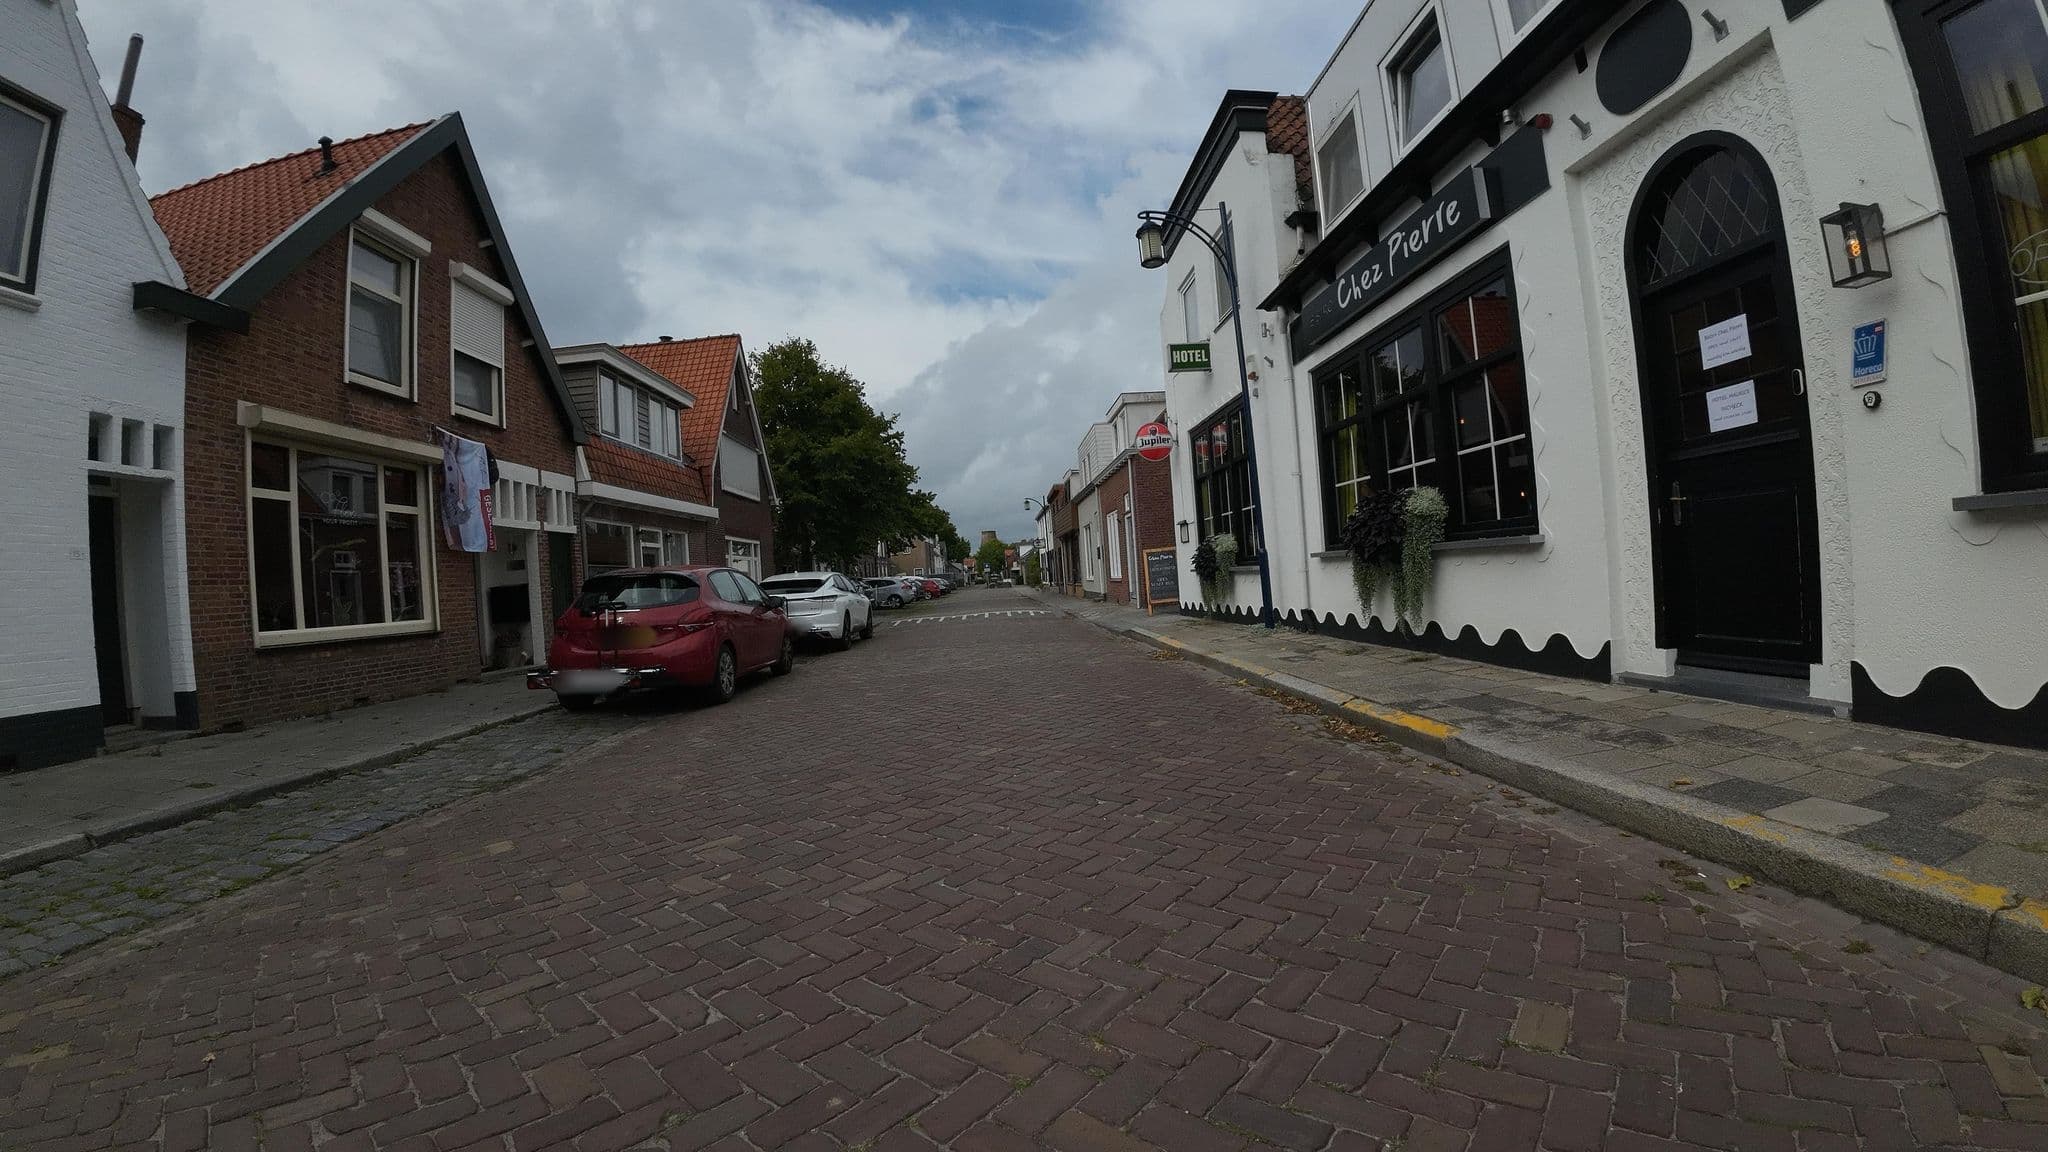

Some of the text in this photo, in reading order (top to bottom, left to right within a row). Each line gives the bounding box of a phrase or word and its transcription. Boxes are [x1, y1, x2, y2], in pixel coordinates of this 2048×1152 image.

[1337, 199, 1461, 309] Chez Pierre
[1172, 349, 1209, 363] HOTEL
[1854, 363, 1883, 377] Horeca
[1139, 435, 1171, 448] Jupiler
